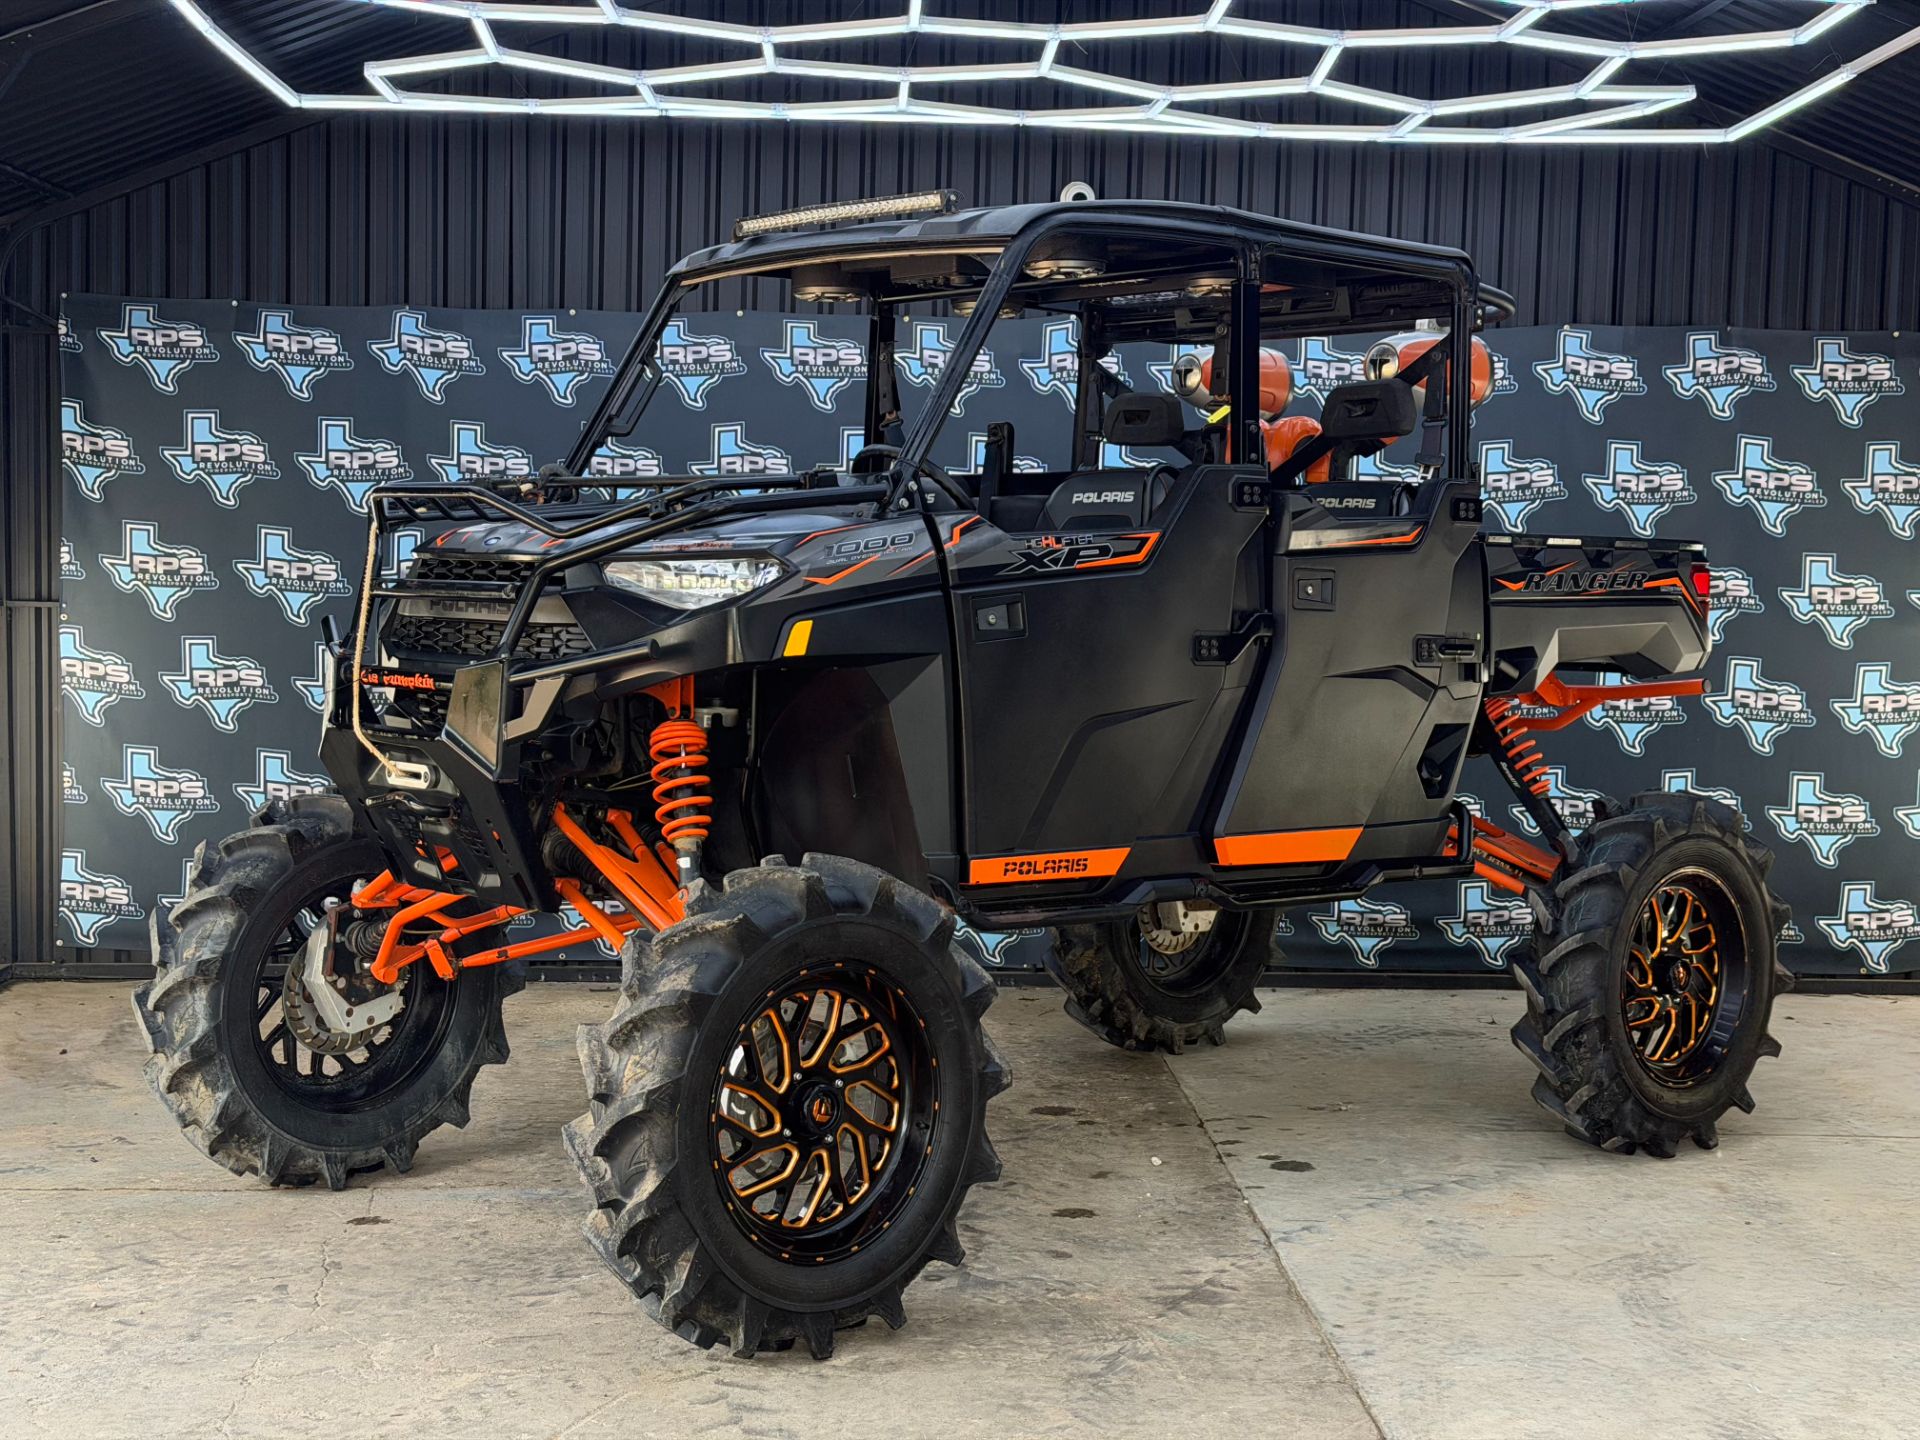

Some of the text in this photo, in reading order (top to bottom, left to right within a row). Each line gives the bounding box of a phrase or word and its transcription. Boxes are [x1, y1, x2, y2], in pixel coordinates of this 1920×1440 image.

[131, 328, 204, 347] RPS
[267, 333, 338, 355] RPS
[137, 346, 210, 355] REVOLUTION
[401, 336, 470, 358] RPS
[532, 342, 602, 361] RPS
[663, 344, 732, 363] RPS
[272, 352, 345, 363] REVOLUTION
[406, 354, 477, 367] REVOLUTION
[537, 361, 608, 369] REVOLUTION
[793, 348, 862, 366] RPS
[668, 361, 738, 372] REVOLUTION
[797, 365, 868, 373] REVOLUTION
[1564, 357, 1634, 380] RPS
[1694, 356, 1763, 378] RPS
[1822, 363, 1891, 381] RPS
[1568, 375, 1639, 388] REVOLUTION
[1698, 373, 1768, 385] REVOLUTION
[62, 432, 129, 457] RPS
[194, 443, 266, 462] RPS
[64, 450, 136, 467] REVOLUTION
[199, 460, 272, 470] REVOLUTION
[328, 450, 399, 469] RPS
[460, 455, 530, 475] RPS
[591, 457, 660, 476] RPS
[720, 456, 788, 475] RPS
[333, 467, 406, 476] REVOLUTION
[1486, 468, 1554, 492] RPS
[1745, 469, 1814, 492] RPS
[1490, 485, 1560, 498] REVOLUTION
[1615, 474, 1684, 491] RPS
[1873, 475, 1920, 493] RP
[1072, 491, 1135, 504] POLARIS
[1749, 487, 1820, 500] REVOLUTION
[1316, 498, 1377, 509] POLARIS
[824, 531, 915, 558] 1000
[133, 555, 204, 574] RPS
[1000, 543, 1114, 575] XP
[137, 573, 210, 583] REVOLUTION
[267, 560, 337, 582] RPS
[271, 578, 343, 589] REVOLUTION
[1521, 571, 1649, 592] RANGER
[1811, 587, 1880, 604] RPS
[62, 658, 130, 682] RPS
[192, 668, 263, 687] RPS
[65, 676, 136, 691] REVOLUTION
[197, 686, 270, 694] REVOLUTION
[1734, 690, 1803, 712] RPS
[1738, 708, 1808, 719] REVOLUTION
[134, 779, 204, 799] RPS
[139, 796, 211, 806] REVOLUTION
[1798, 805, 1866, 822] RPS
[1004, 858, 1088, 876] POLARIS
[61, 882, 130, 904] RPS
[63, 898, 135, 913] REVOLUTION
[1340, 912, 1407, 928] RPS
[1466, 908, 1533, 926] RPS
[1849, 910, 1915, 931] RPS
